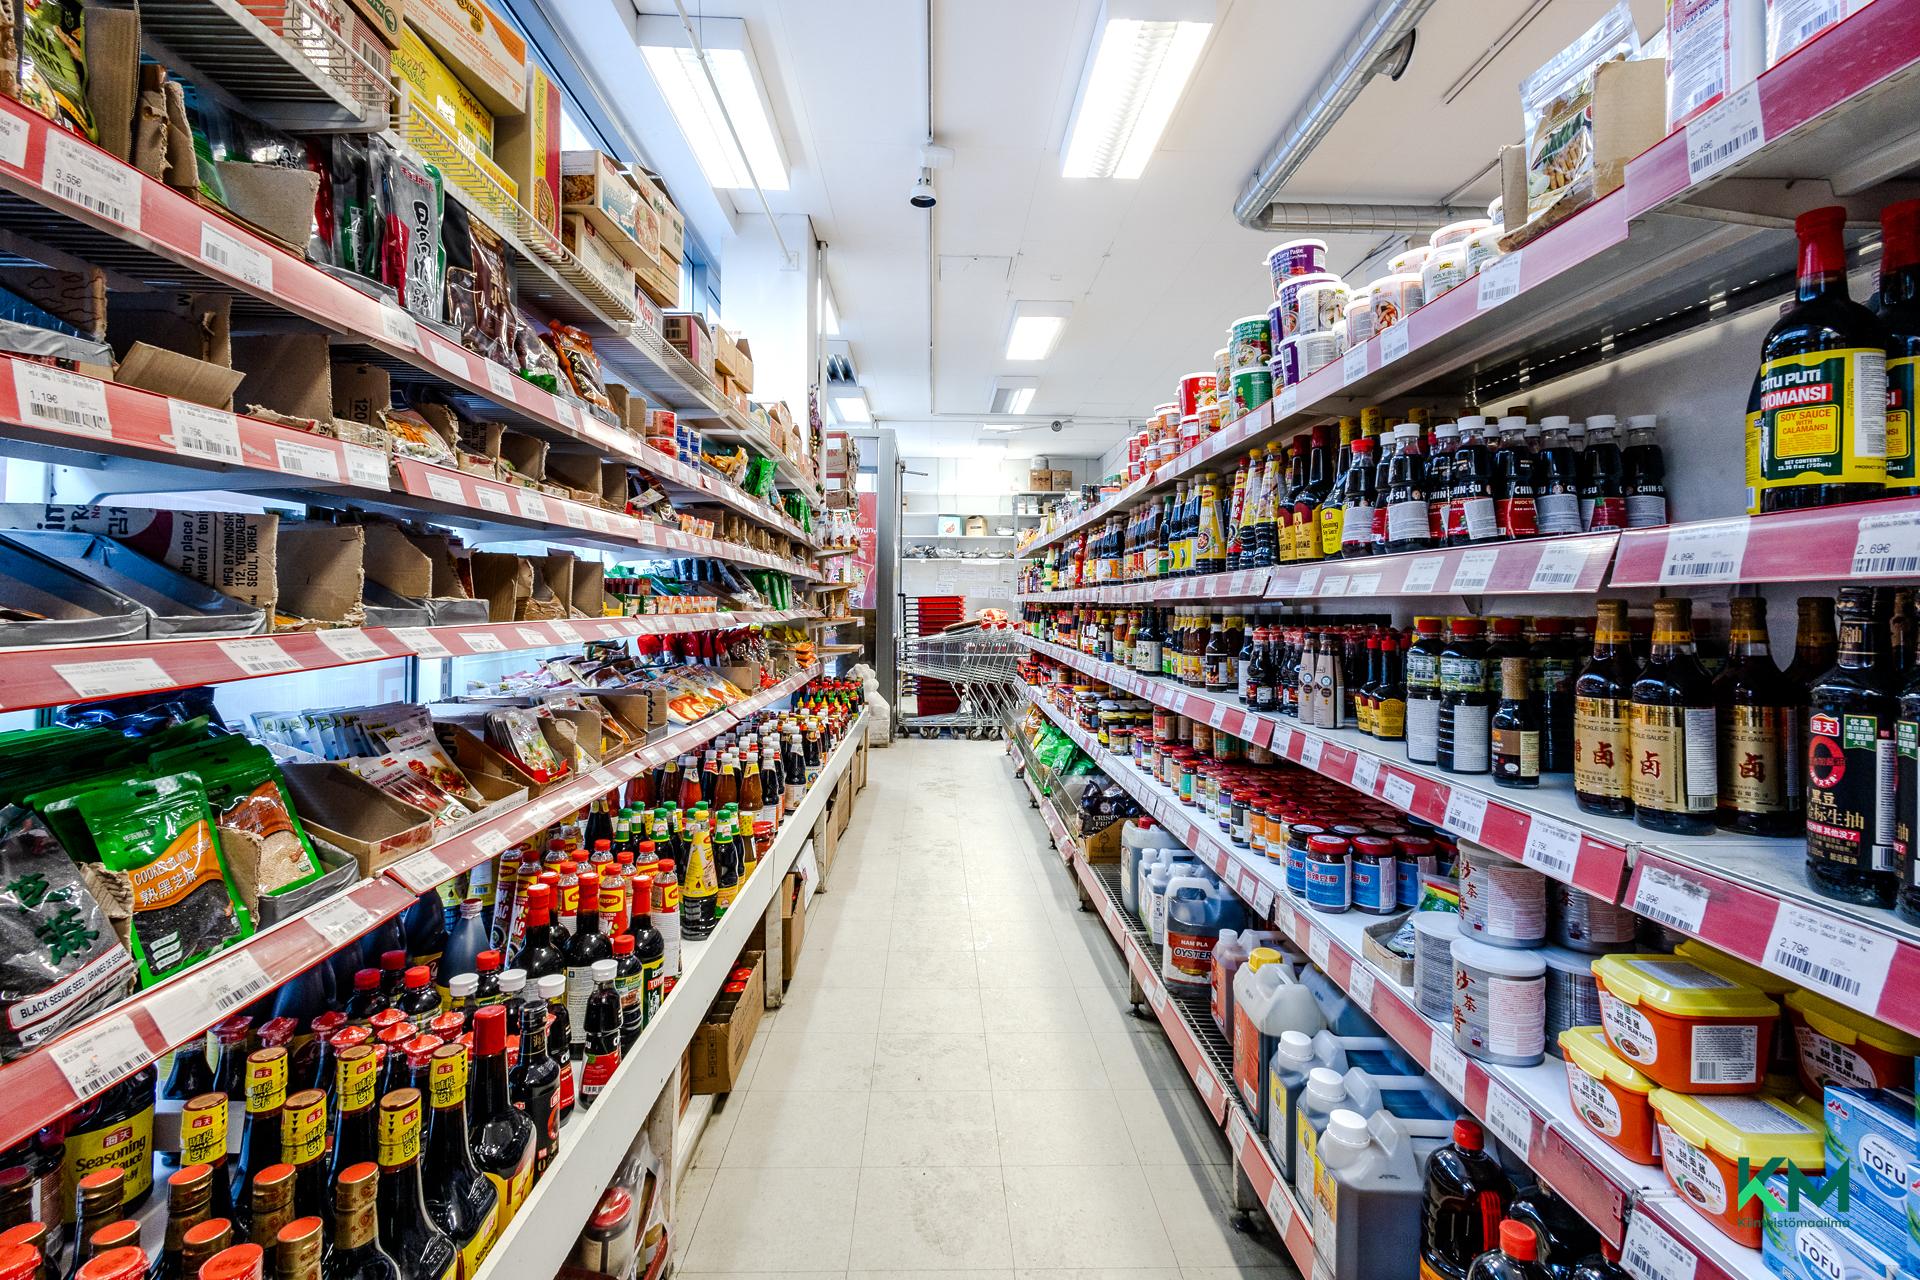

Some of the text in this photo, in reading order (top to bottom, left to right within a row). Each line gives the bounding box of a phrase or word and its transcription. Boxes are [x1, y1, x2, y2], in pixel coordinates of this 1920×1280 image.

[30, 389, 58, 404] 1.19€
[1780, 409, 1831, 422] SOY SAUCE
[1782, 424, 1828, 435] CALAMANSI
[181, 521, 193, 552] place
[246, 525, 258, 587] SEOUL, KOREA
[1857, 544, 1891, 555] 2.69€
[223, 568, 234, 587] MFG
[235, 569, 247, 587] 112,
[1600, 726, 1622, 734] SAUCE
[1646, 734, 1669, 742] SAUCE
[1638, 889, 1659, 905] 2.99€
[1174, 948, 1212, 959] OYSTER
[1780, 937, 1809, 956] 2.79€
[20, 999, 49, 1019] BLACK
[50, 985, 73, 1006] SESAME
[72, 976, 86, 994] SEED
[76, 1136, 147, 1172] Seasoning
[1863, 1147, 1906, 1185] TOFU
[1801, 1237, 1841, 1279] TOFU
